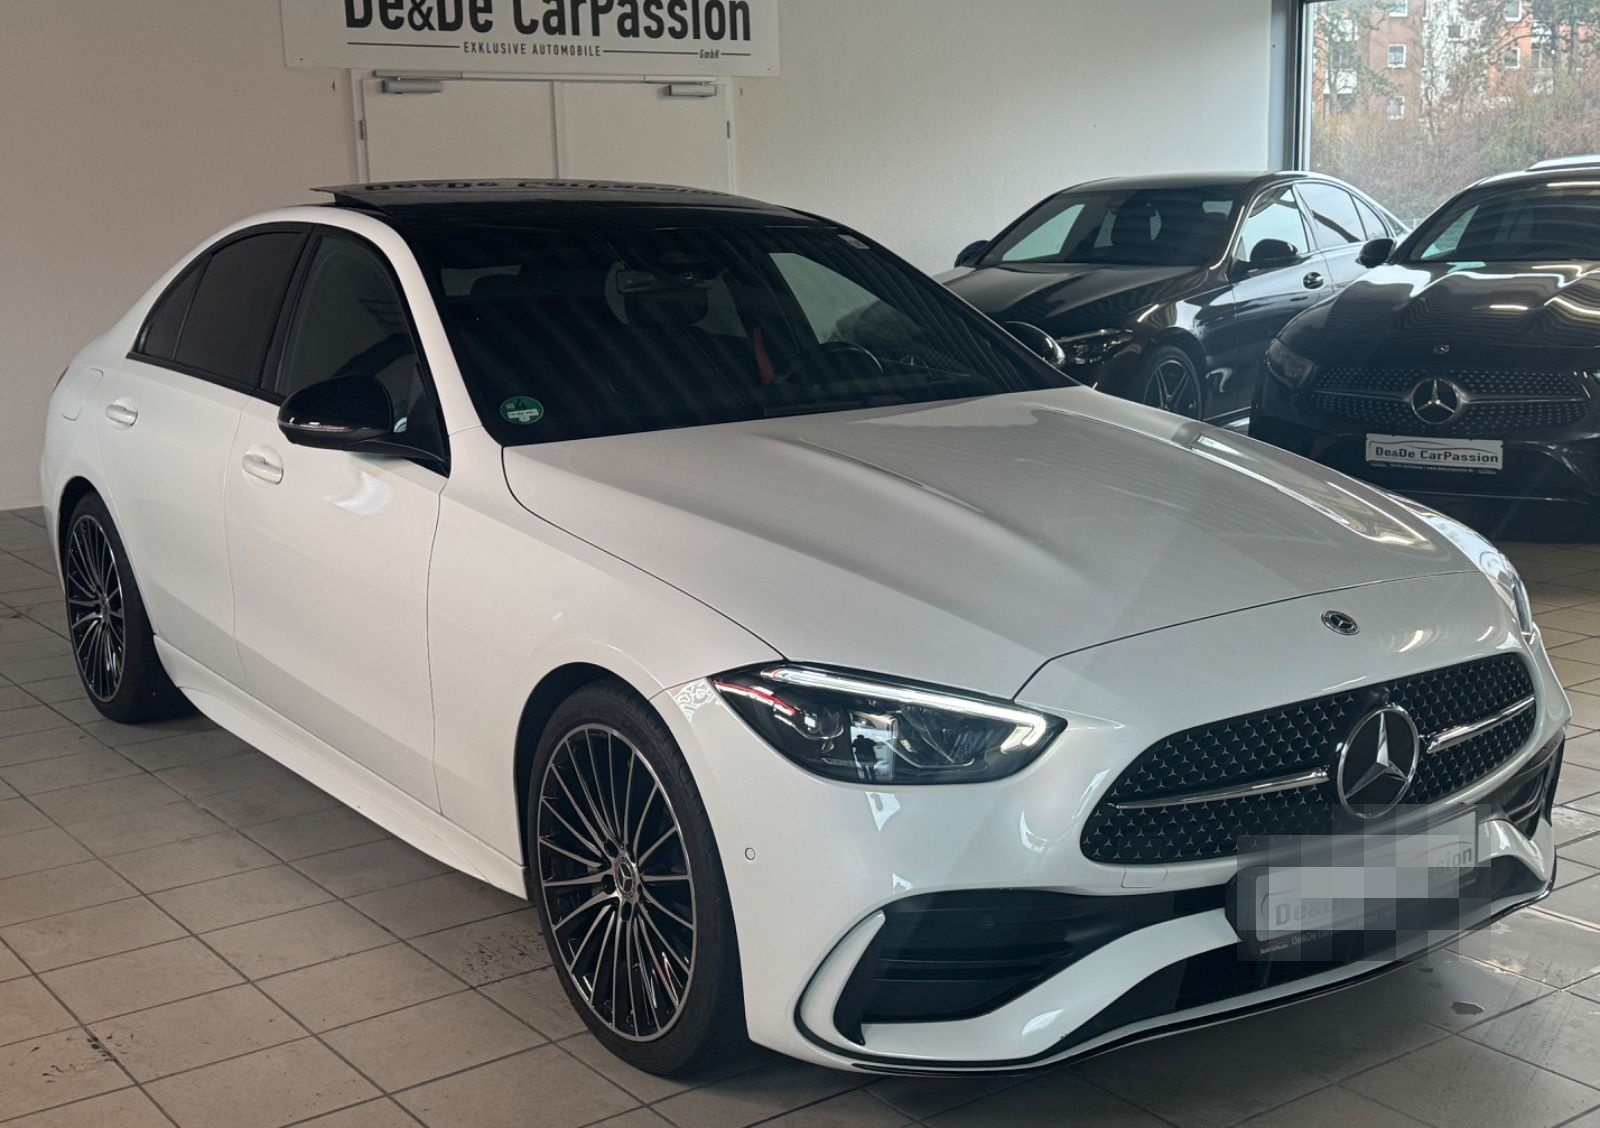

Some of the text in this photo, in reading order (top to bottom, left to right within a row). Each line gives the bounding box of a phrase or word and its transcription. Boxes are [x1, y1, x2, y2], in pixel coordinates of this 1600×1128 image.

[344, 0, 751, 41] De&De CarPassion
[464, 41, 601, 57] EXKLUSIVE AUTOMOBILE
[699, 49, 720, 59] GmbH
[1420, 449, 1499, 463] CarPassion
